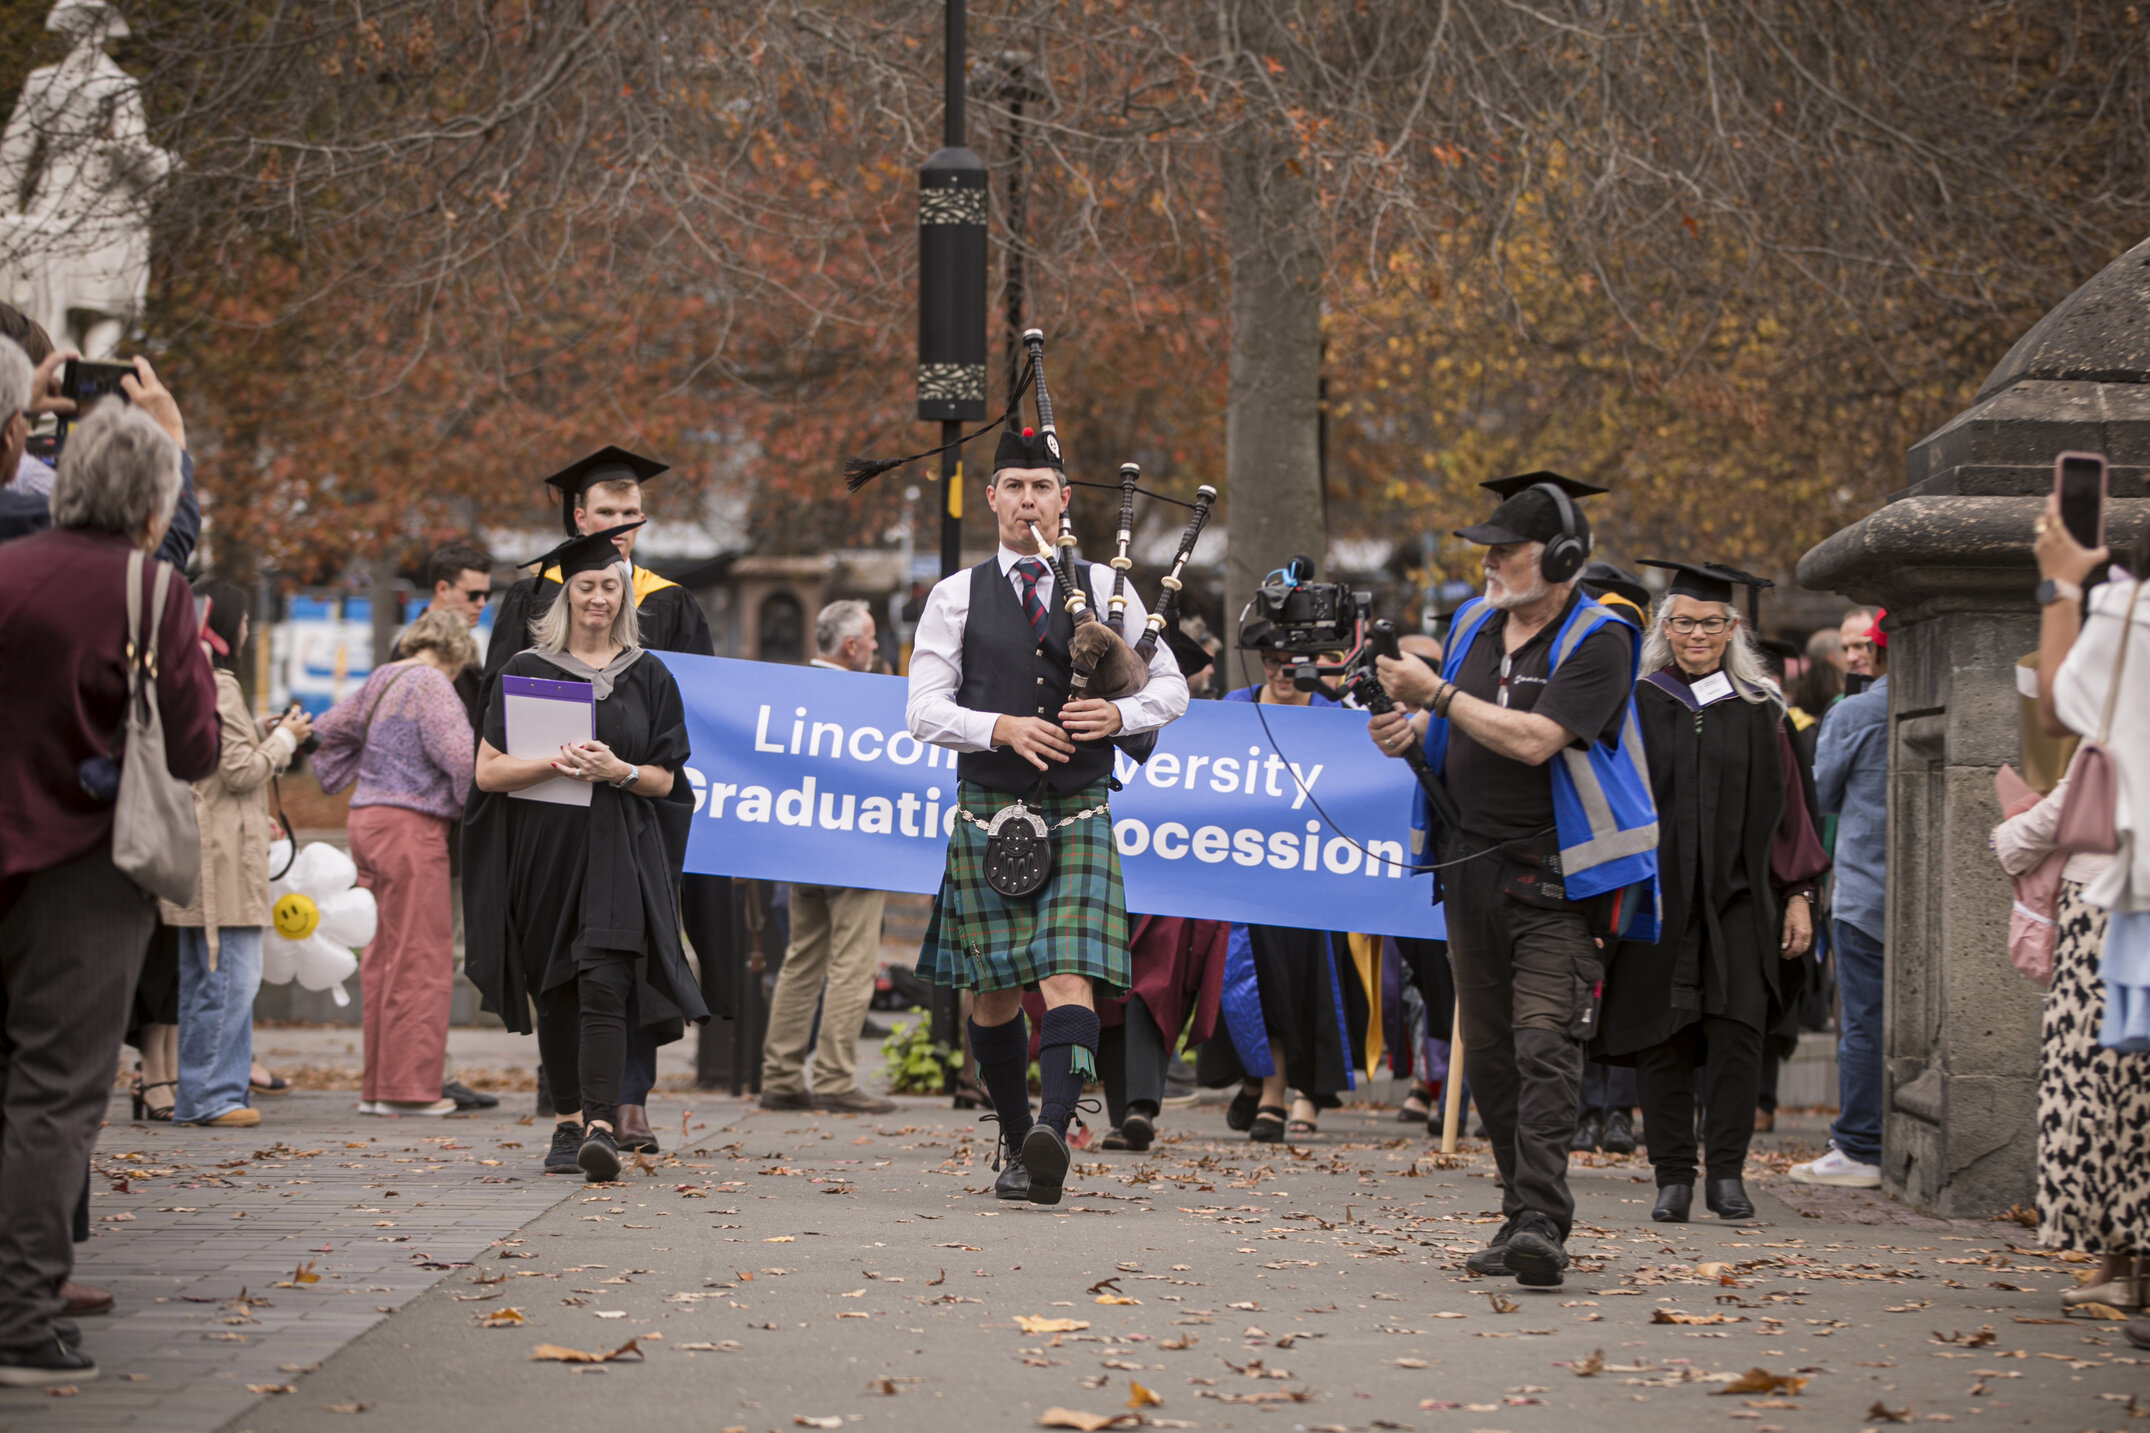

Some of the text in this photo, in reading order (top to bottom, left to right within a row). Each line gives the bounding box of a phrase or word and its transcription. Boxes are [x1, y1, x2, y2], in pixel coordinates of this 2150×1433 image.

[755, 704, 1324, 810] Linco versity
[683, 766, 1404, 879] raduati ocession
